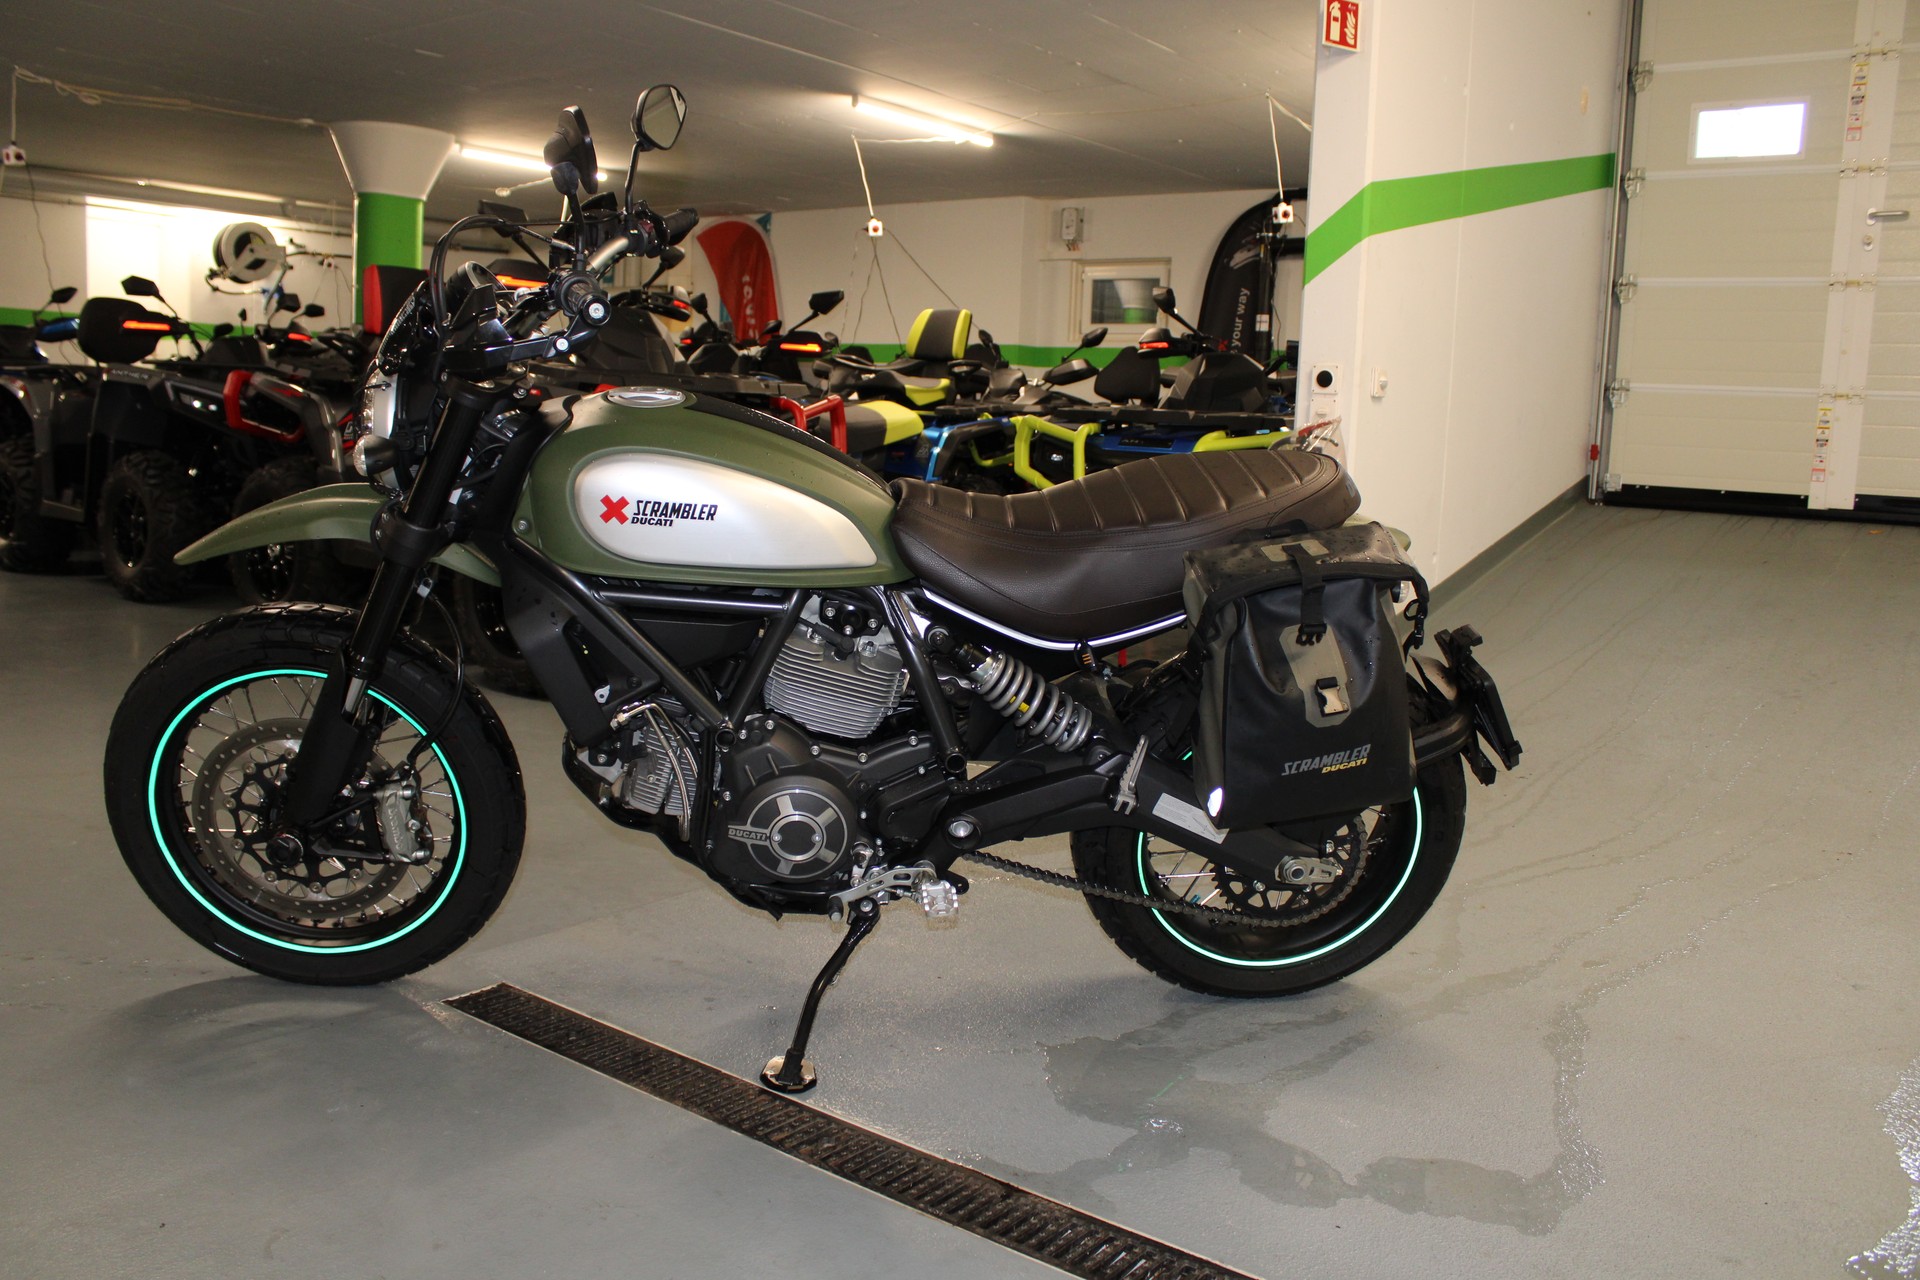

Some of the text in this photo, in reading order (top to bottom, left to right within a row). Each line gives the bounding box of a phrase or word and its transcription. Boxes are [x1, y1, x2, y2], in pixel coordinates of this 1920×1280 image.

[1231, 316, 1243, 347] your
[1237, 287, 1250, 315] way
[632, 499, 719, 521] SCRAMBLER
[630, 516, 675, 527] DUCATI
[1281, 743, 1372, 776] SCRAMBLER
[1321, 757, 1368, 774] DUCATI
[728, 829, 766, 841] DUCATI
